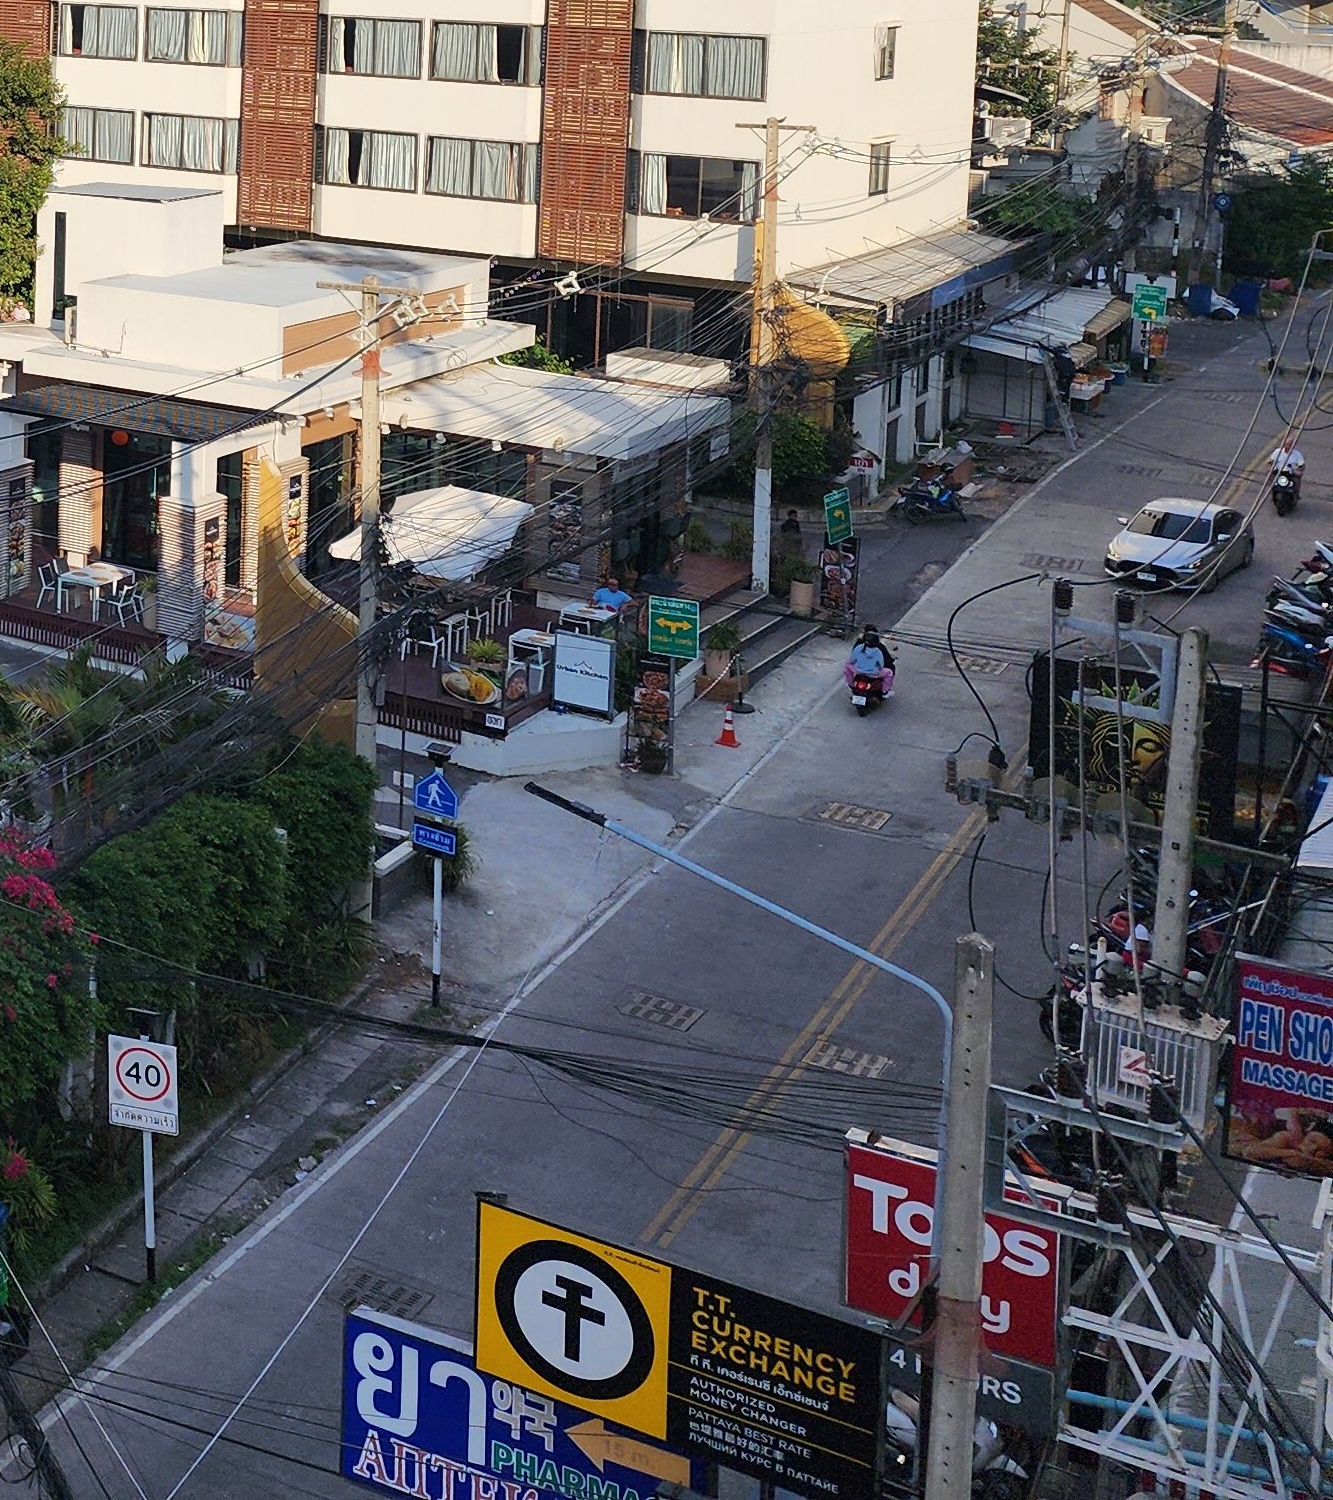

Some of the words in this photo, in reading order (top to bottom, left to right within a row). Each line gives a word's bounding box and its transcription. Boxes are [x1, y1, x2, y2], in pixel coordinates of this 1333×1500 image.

[579, 669, 609, 680] Kitchen
[1239, 998, 1284, 1055] PEN
[125, 1061, 161, 1088] 40
[1242, 1057, 1333, 1104] MASSAGE
[853, 1173, 1051, 1277] Tos
[692, 1286, 736, 1318] T.T.
[691, 1310, 856, 1380] CURRENCY
[691, 1330, 856, 1403] EXCHANGE
[352, 1332, 486, 1466] ยา
[491, 1380, 558, 1452] 약국
[689, 1388, 737, 1412] MONEY
[740, 1406, 807, 1437] CHANGER
[690, 1376, 776, 1413] AUTHORIZED
[688, 1406, 742, 1434] PATTAYA
[744, 1427, 776, 1446] BEST
[778, 1439, 812, 1459] RATE
[741, 1451, 772, 1469] КУРС
[775, 1463, 784, 1473] В
